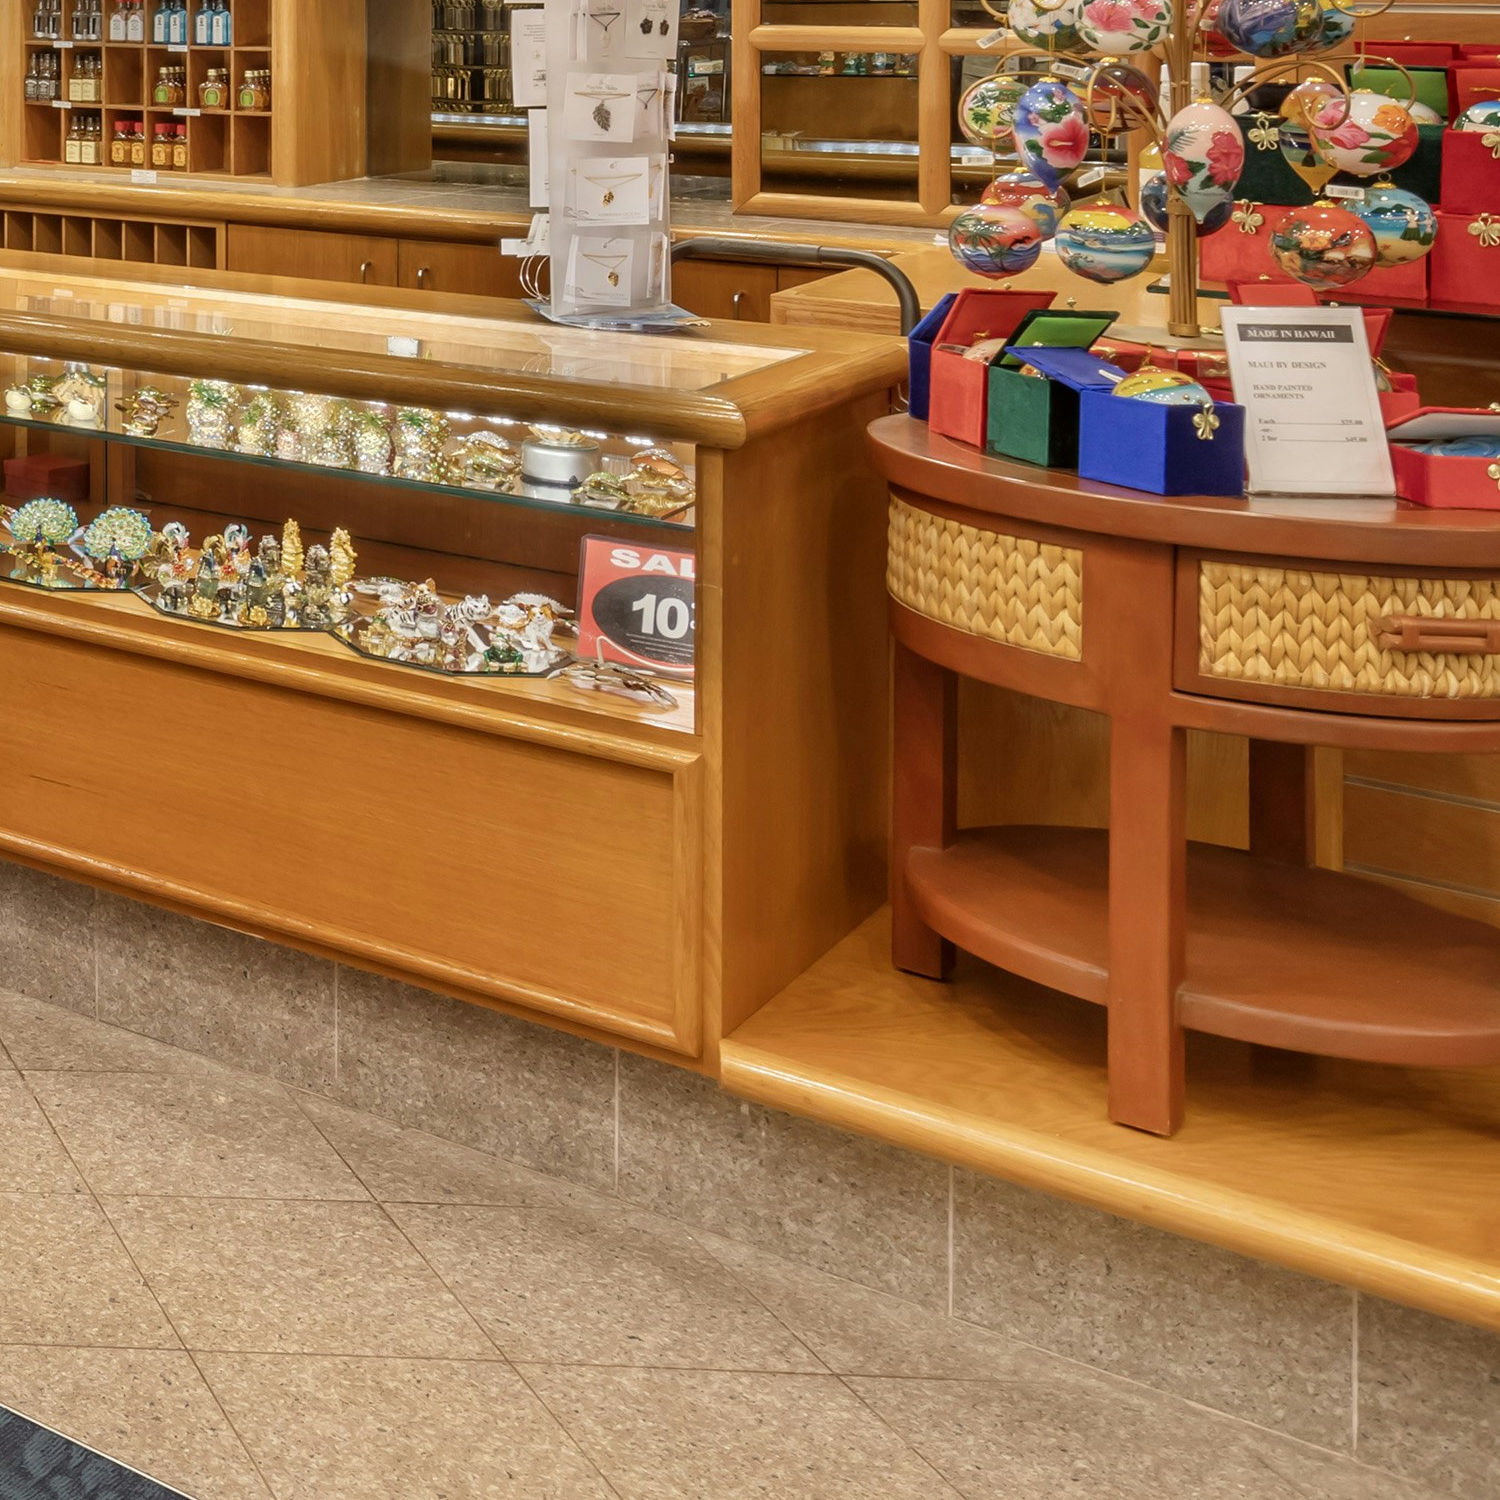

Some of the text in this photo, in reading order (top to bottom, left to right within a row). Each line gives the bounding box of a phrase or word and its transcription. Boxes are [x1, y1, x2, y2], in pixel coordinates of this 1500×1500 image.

[1247, 330, 1336, 339] MADE IN HAWAII
[1248, 361, 1274, 369] MAUI
[1276, 361, 1288, 369] BY
[610, 548, 695, 578] SAL
[632, 593, 690, 639] 10
